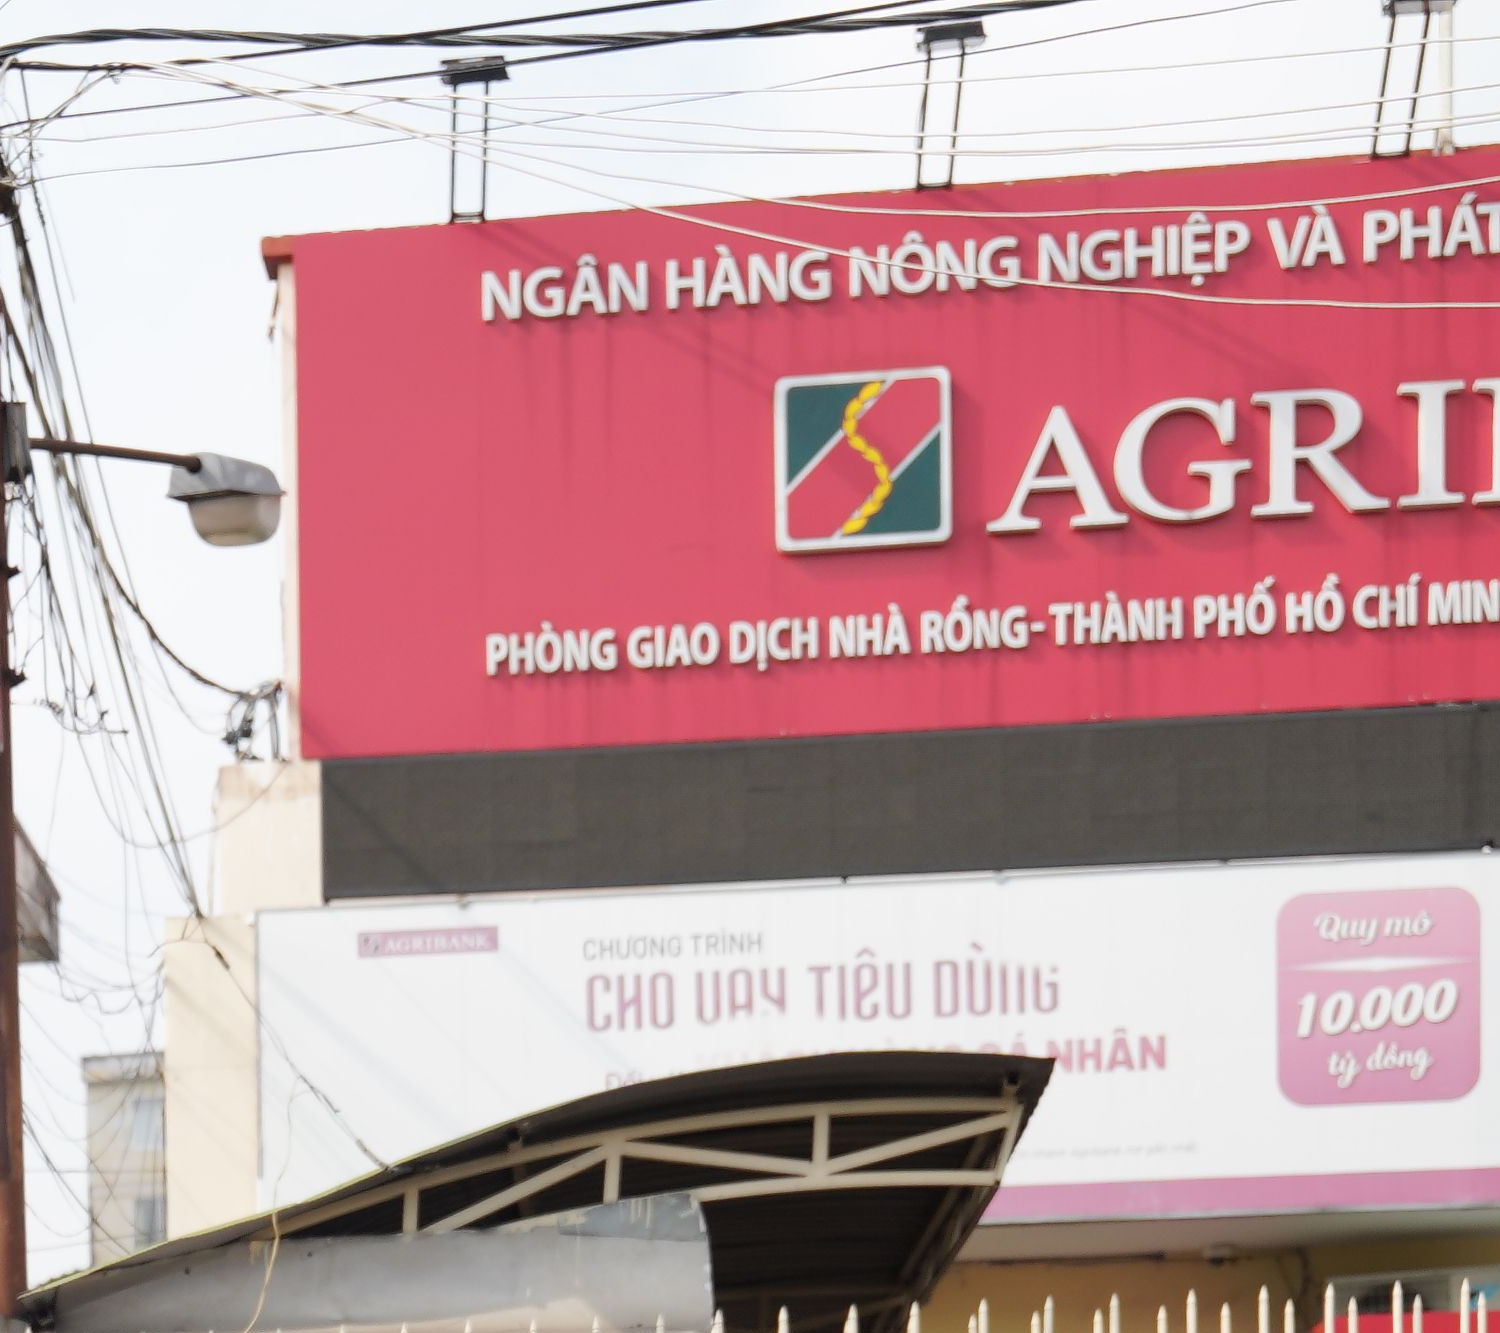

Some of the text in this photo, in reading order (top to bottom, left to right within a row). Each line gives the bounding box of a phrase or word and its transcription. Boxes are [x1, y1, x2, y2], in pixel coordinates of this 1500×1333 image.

[481, 258, 650, 324] NGÂN
[666, 242, 831, 311] HÀNG
[847, 233, 1020, 298] NÔNG
[1037, 211, 1251, 286] NGHIỆP
[1267, 205, 1345, 270] VÀ
[486, 621, 617, 676] PHÒNG
[627, 622, 720, 668] GIAO
[730, 617, 818, 672] DỊCH
[829, 603, 910, 658] NHÀ
[1194, 575, 1276, 638] PHỐ
[1353, 571, 1421, 629] CHÍ
[386, 934, 489, 954] AGRIBANK
[583, 932, 763, 961] CHƯƠNG TRÌNH
[1313, 908, 1434, 946] Quy mô
[586, 970, 674, 1033] CHO
[1296, 978, 1459, 1038] 10.000
